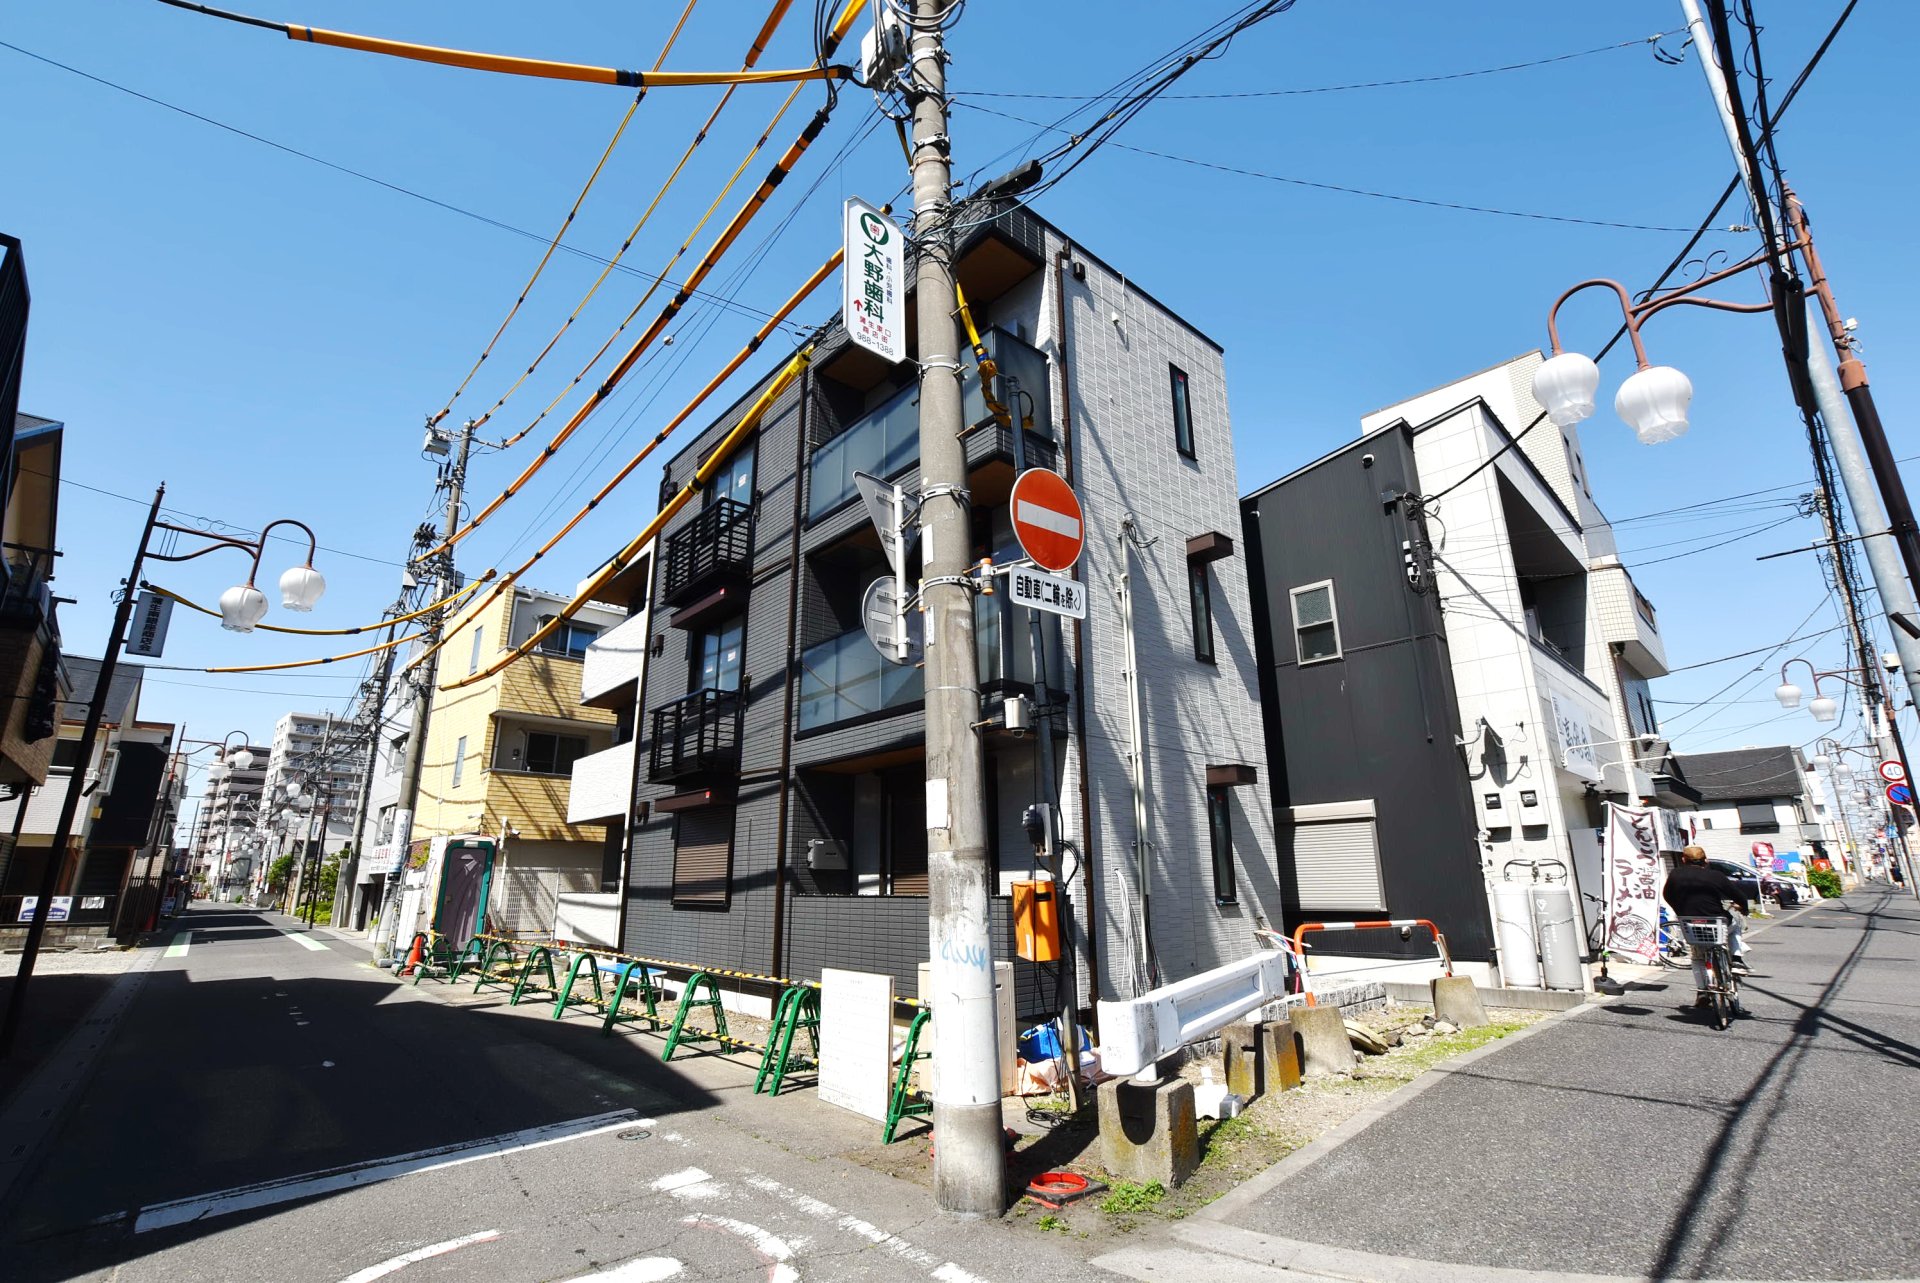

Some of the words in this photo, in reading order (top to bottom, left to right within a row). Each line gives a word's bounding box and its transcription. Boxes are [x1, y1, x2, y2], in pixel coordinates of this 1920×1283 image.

[863, 242, 885, 324] 大野歯科
[856, 332, 894, 356] 988-1388
[862, 326, 888, 344] 商店街
[1886, 766, 1902, 776] 40
[1615, 858, 1634, 918] ラーメン
